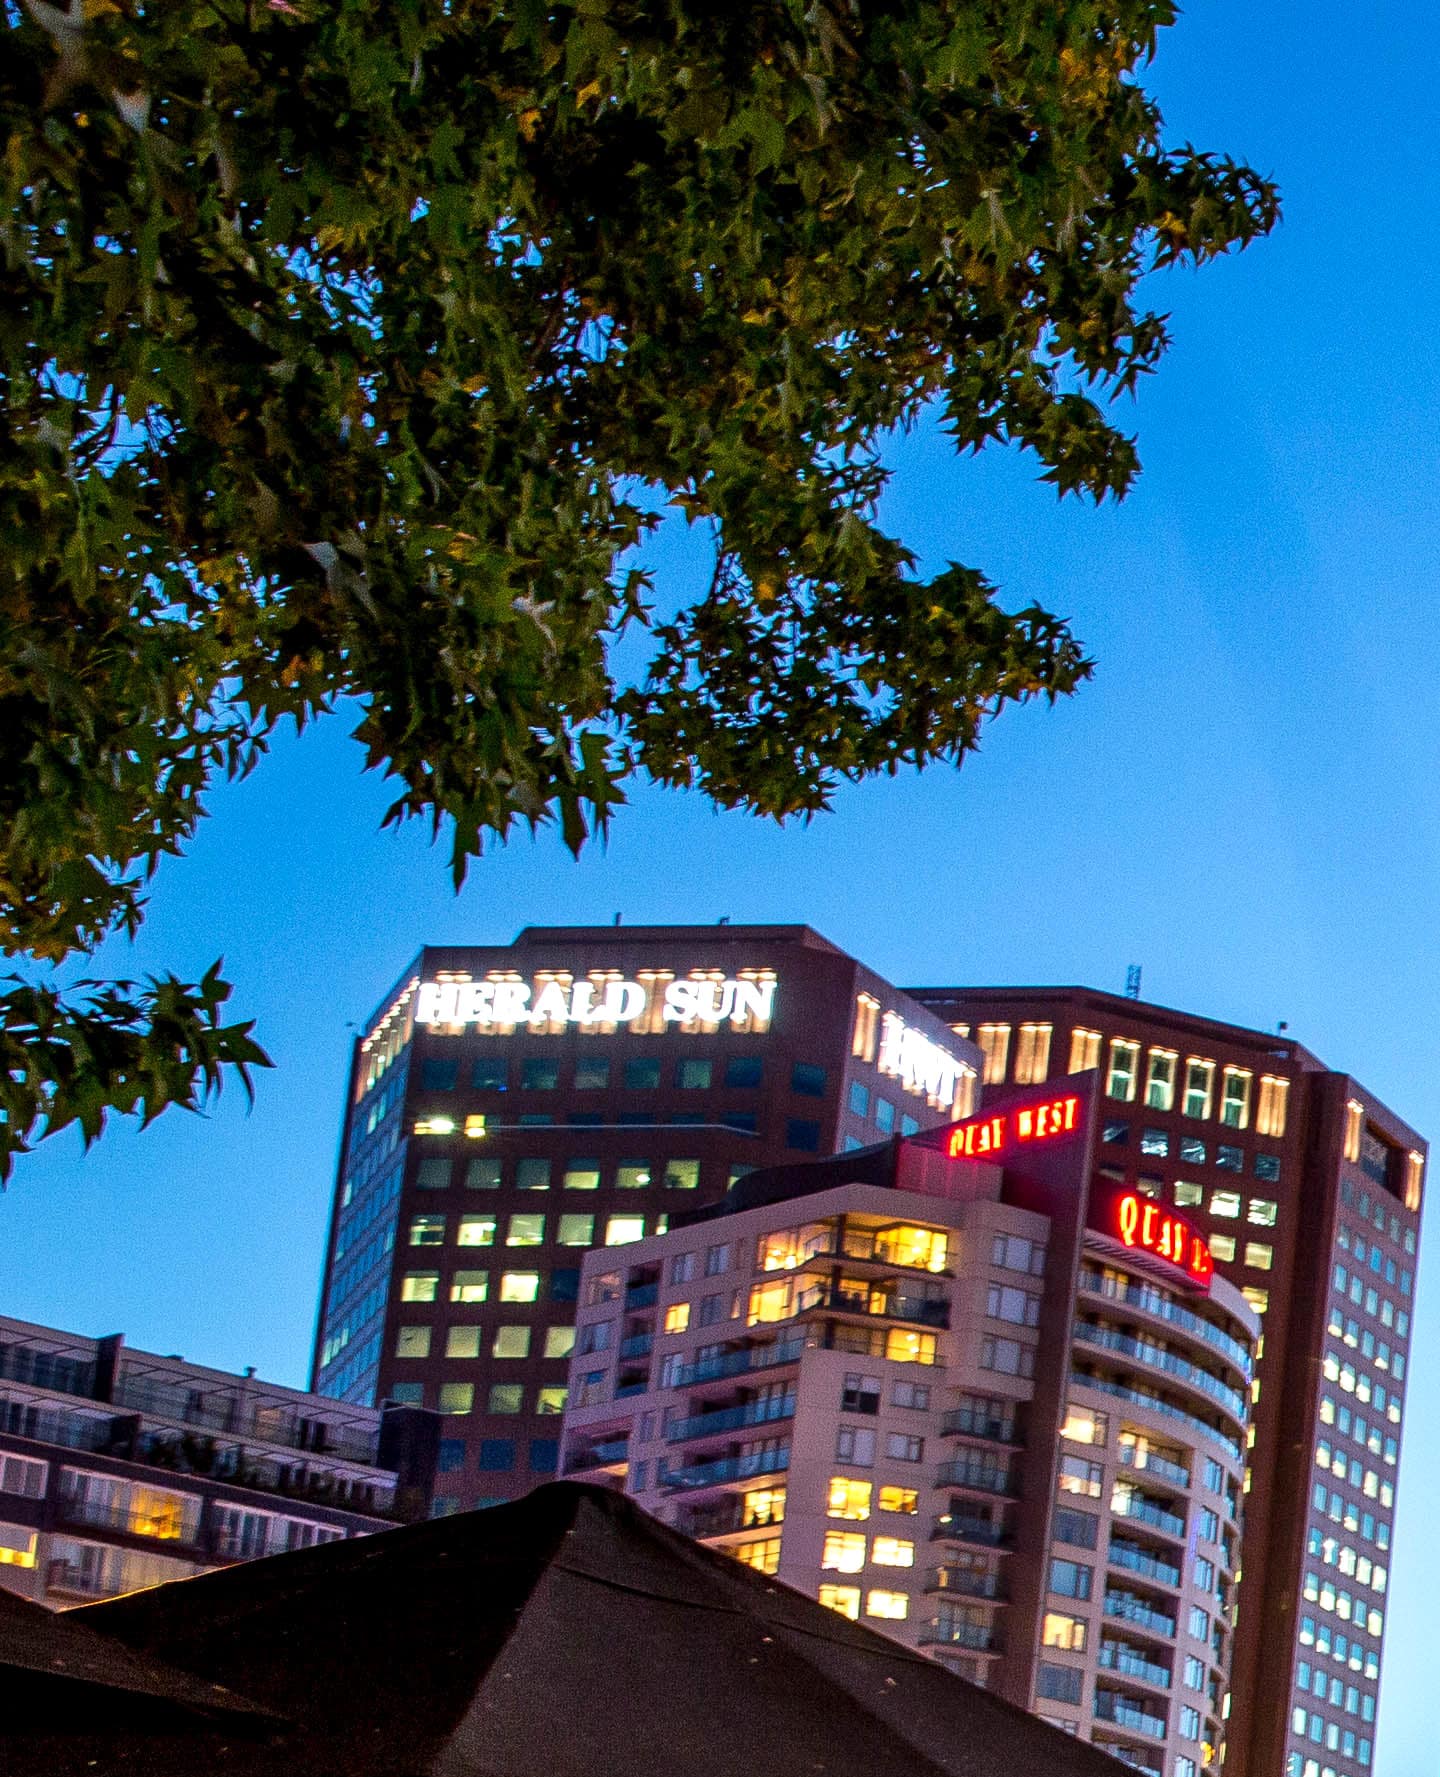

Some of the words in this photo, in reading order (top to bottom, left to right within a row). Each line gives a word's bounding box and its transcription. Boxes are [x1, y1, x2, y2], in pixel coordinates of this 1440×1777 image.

[414, 981, 646, 1023] HERALD
[664, 980, 778, 1023] SUN
[949, 1117, 1006, 1157] QUAY
[1017, 1098, 1077, 1138] WEST
[1119, 1195, 1186, 1264] QUAY
